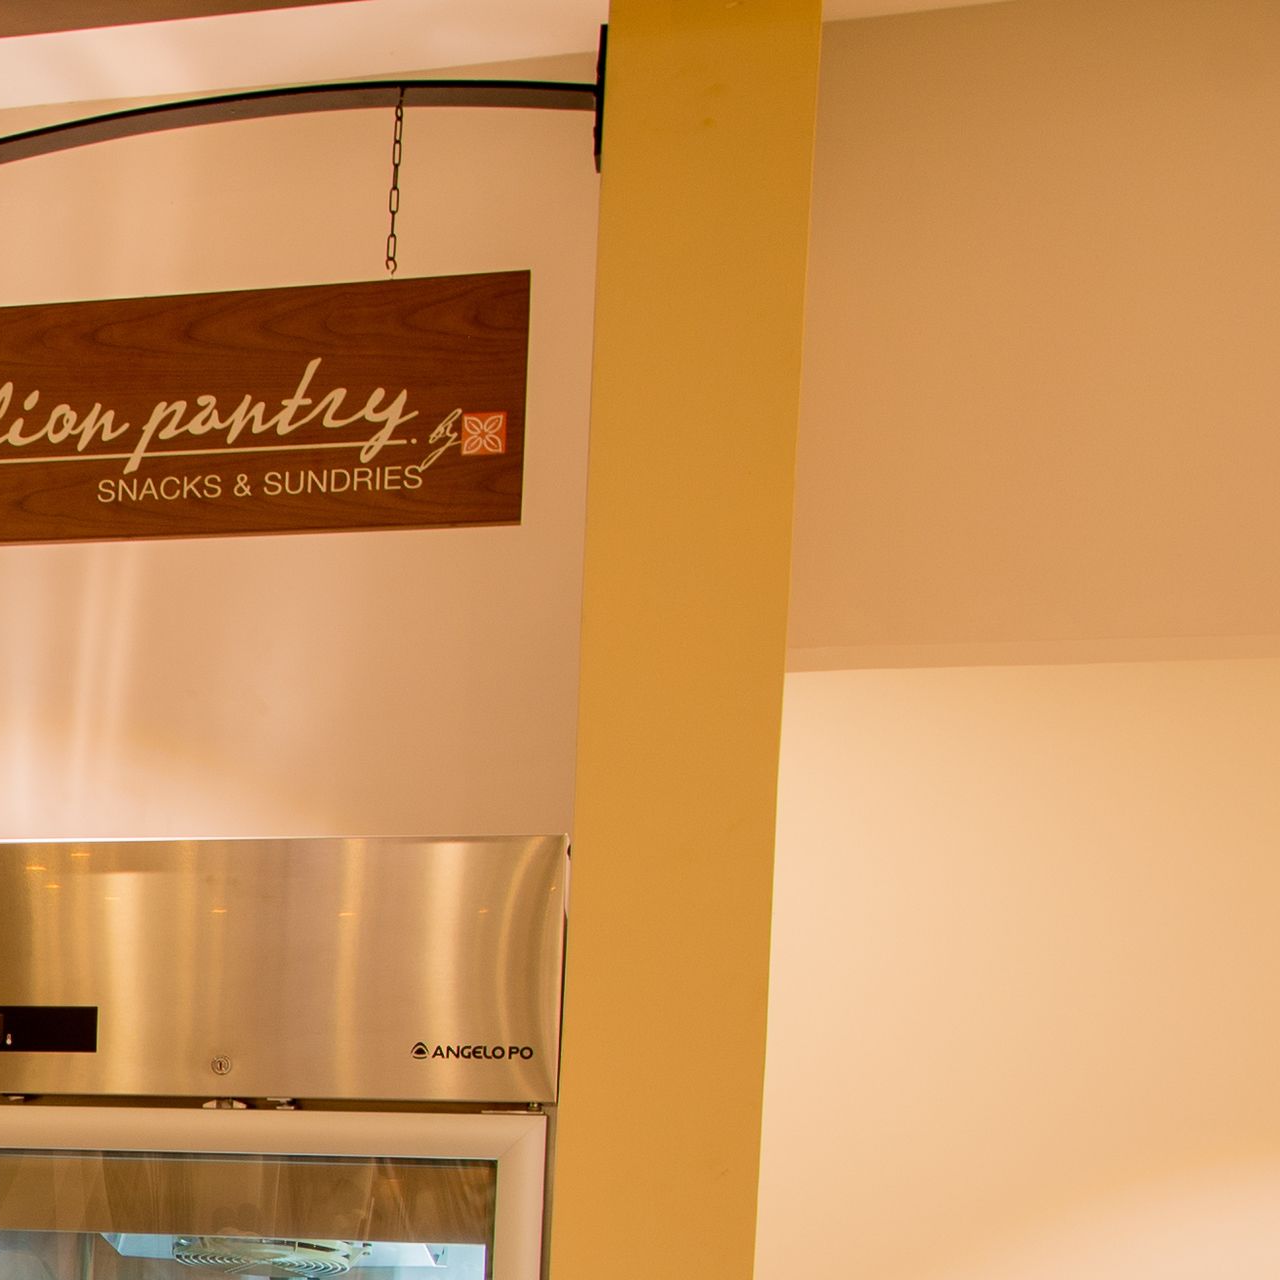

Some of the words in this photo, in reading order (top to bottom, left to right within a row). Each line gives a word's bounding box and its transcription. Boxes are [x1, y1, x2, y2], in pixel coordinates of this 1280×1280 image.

[123, 357, 420, 475] pantry
[96, 474, 222, 503] SNACKS
[232, 473, 252, 497] &
[262, 463, 424, 496] SUNDRIES
[432, 1045, 505, 1060] ANGELO
[508, 1046, 534, 1060] PO
